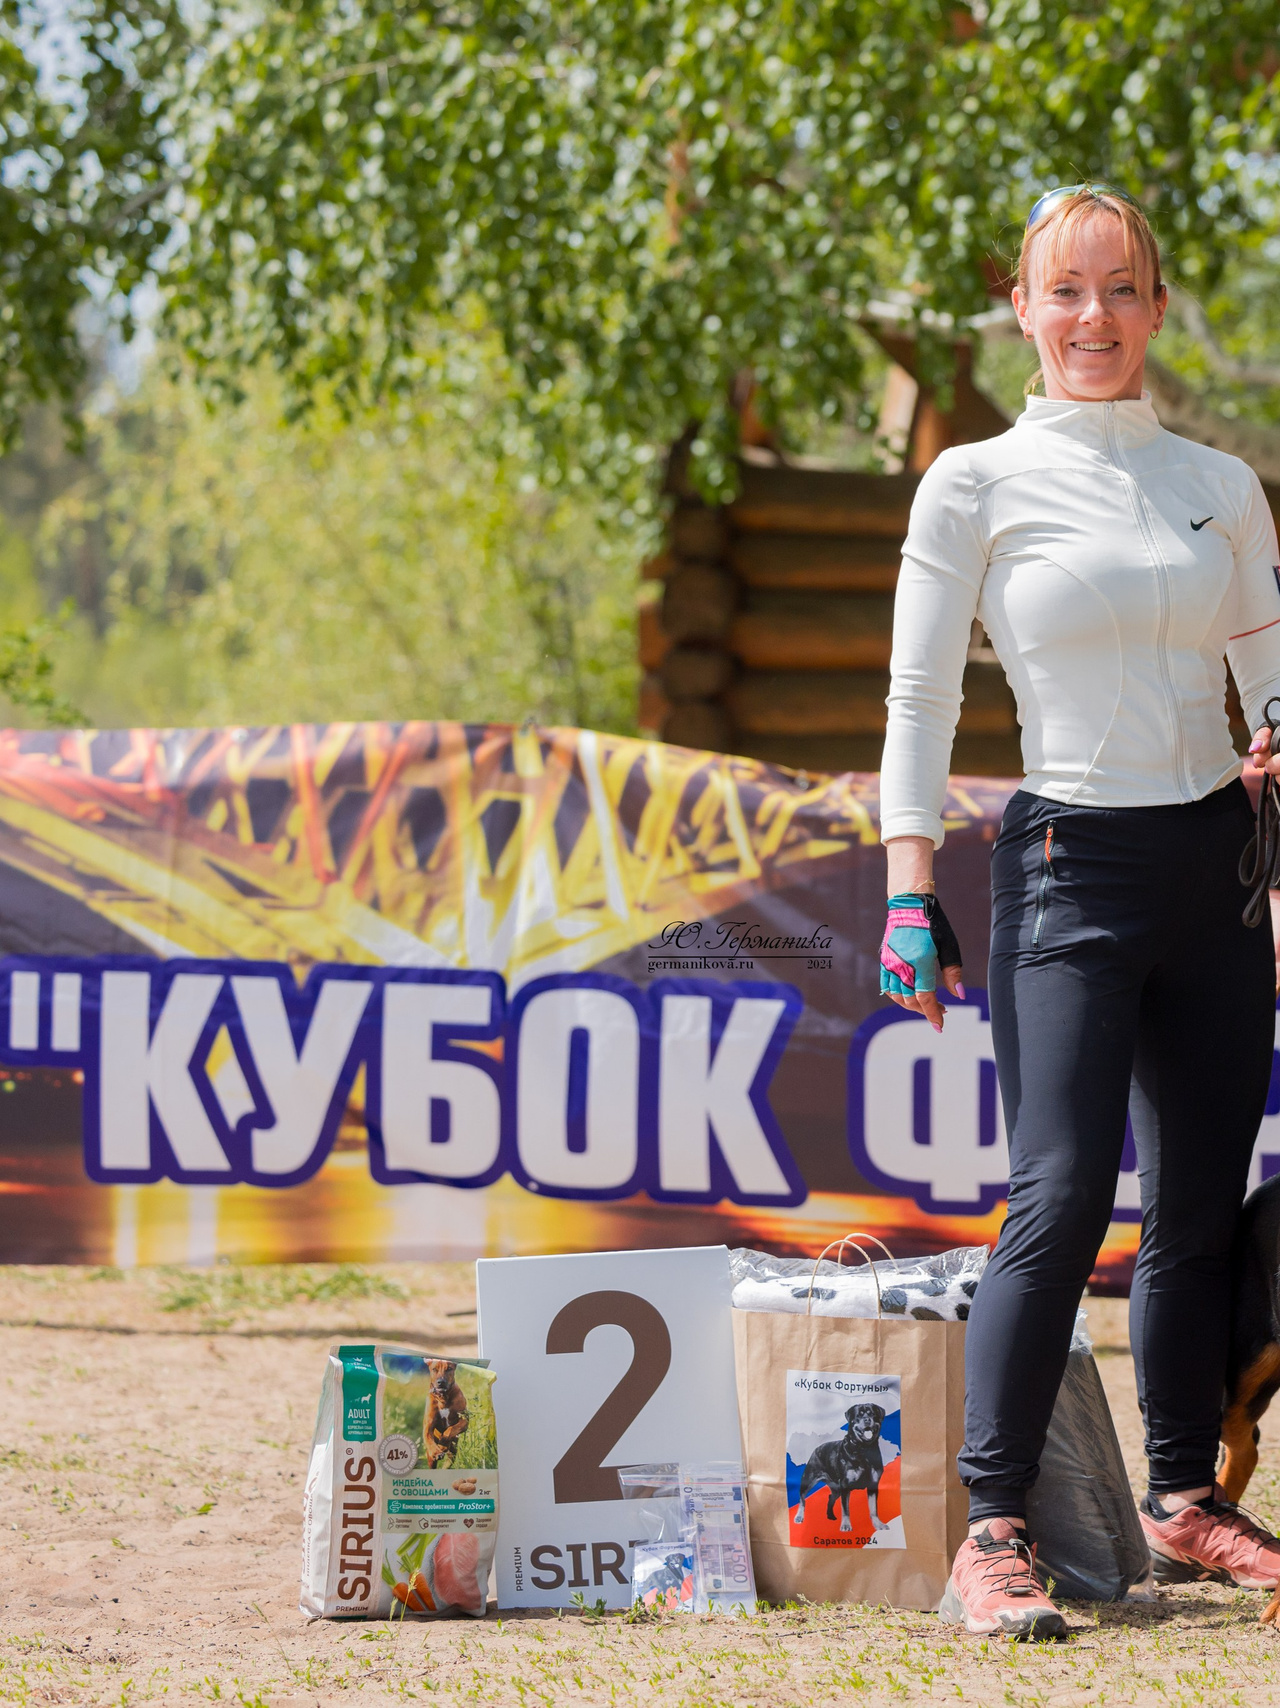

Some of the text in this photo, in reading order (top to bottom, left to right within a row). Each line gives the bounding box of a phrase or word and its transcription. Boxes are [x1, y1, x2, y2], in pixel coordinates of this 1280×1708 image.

[9, 968, 795, 1196] "КУБОК
[794, 1378, 889, 1394] «Кубок Фортуны»
[546, 1290, 680, 1504] 2
[348, 1408, 370, 1419] ADULT
[387, 1449, 408, 1461] 41%
[392, 1478, 434, 1487] ИНДЕЙКА
[392, 1488, 448, 1497] С ОВОЩАМИ
[458, 1502, 491, 1510] ProStor+
[813, 1536, 878, 1547] Саратов 2024
[514, 1547, 523, 1591] PREMIUM
[530, 1540, 641, 1590] SIR
